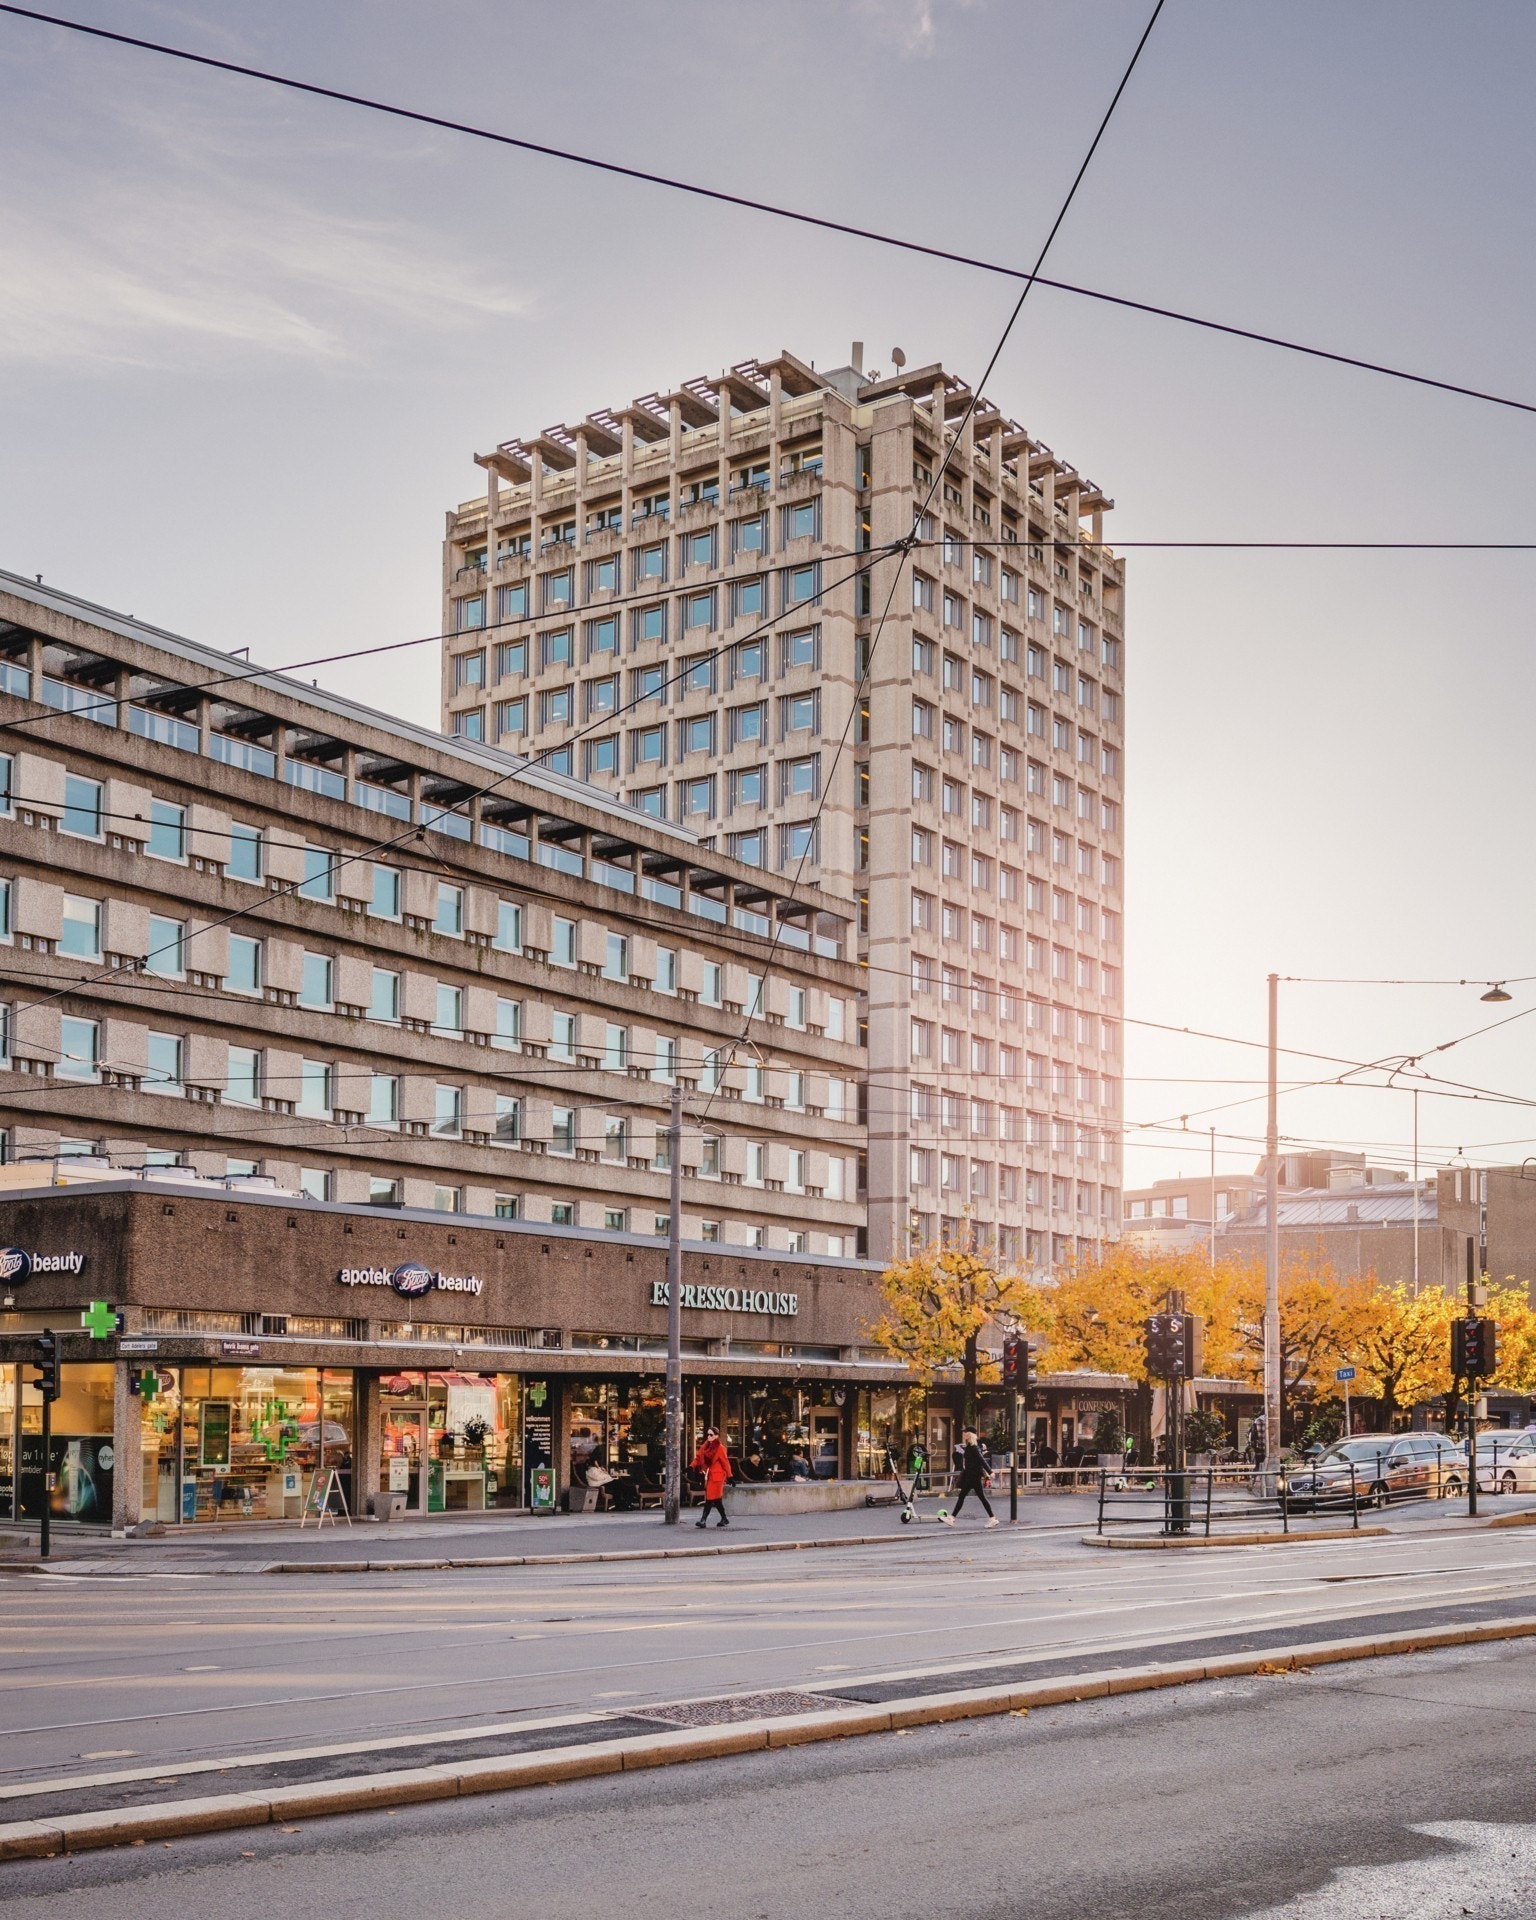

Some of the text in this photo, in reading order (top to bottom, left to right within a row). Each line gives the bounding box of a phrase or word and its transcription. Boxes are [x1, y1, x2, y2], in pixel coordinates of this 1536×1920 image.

[33, 1251, 83, 1274] beauty
[340, 1267, 483, 1296] apotek Boots beauty
[742, 1289, 798, 1316] HOUSE
[1339, 1369, 1353, 1379] Taxi
[22, 1451, 33, 1461] av
